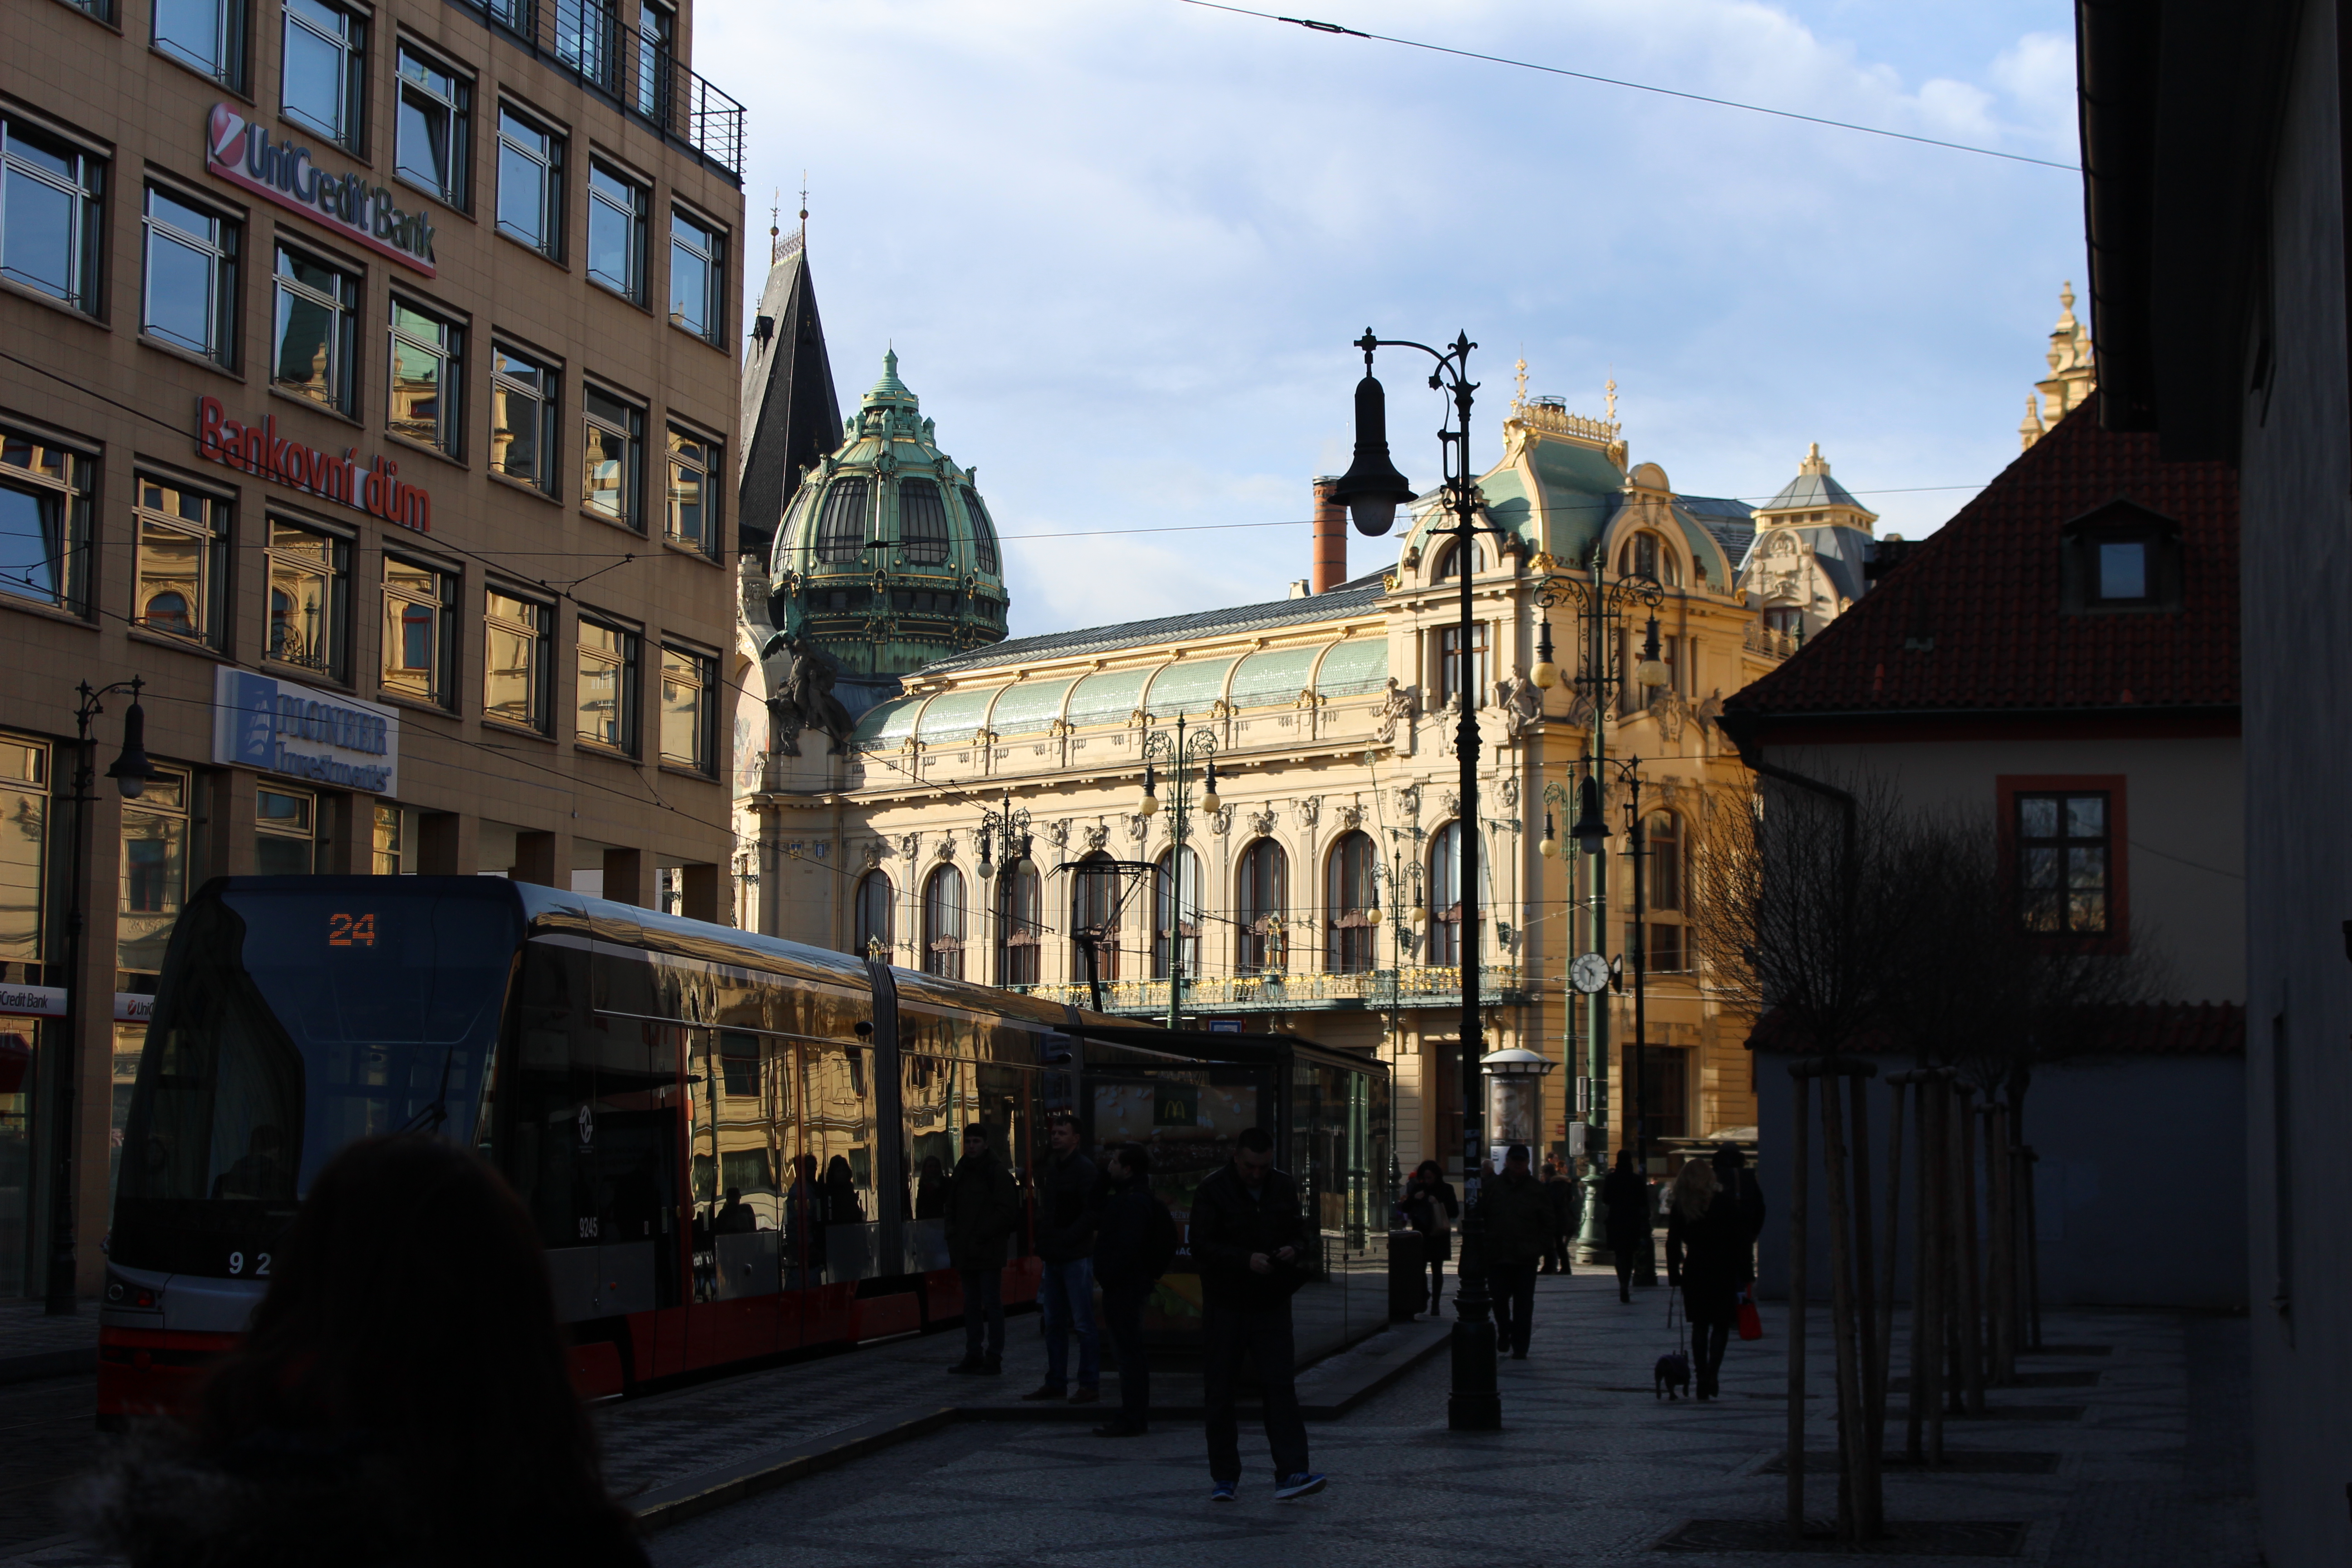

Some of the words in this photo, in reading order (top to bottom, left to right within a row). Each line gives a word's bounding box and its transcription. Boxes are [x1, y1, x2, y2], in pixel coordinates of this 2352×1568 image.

[248, 122, 373, 230] UniCredit
[373, 186, 436, 264] Bank
[197, 396, 358, 505] Bankovní
[365, 455, 431, 532] dům
[277, 693, 387, 755] PIONEER
[329, 914, 375, 946] 24
[27, 993, 49, 1009] Bank
[579, 1217, 598, 1238] 9245
